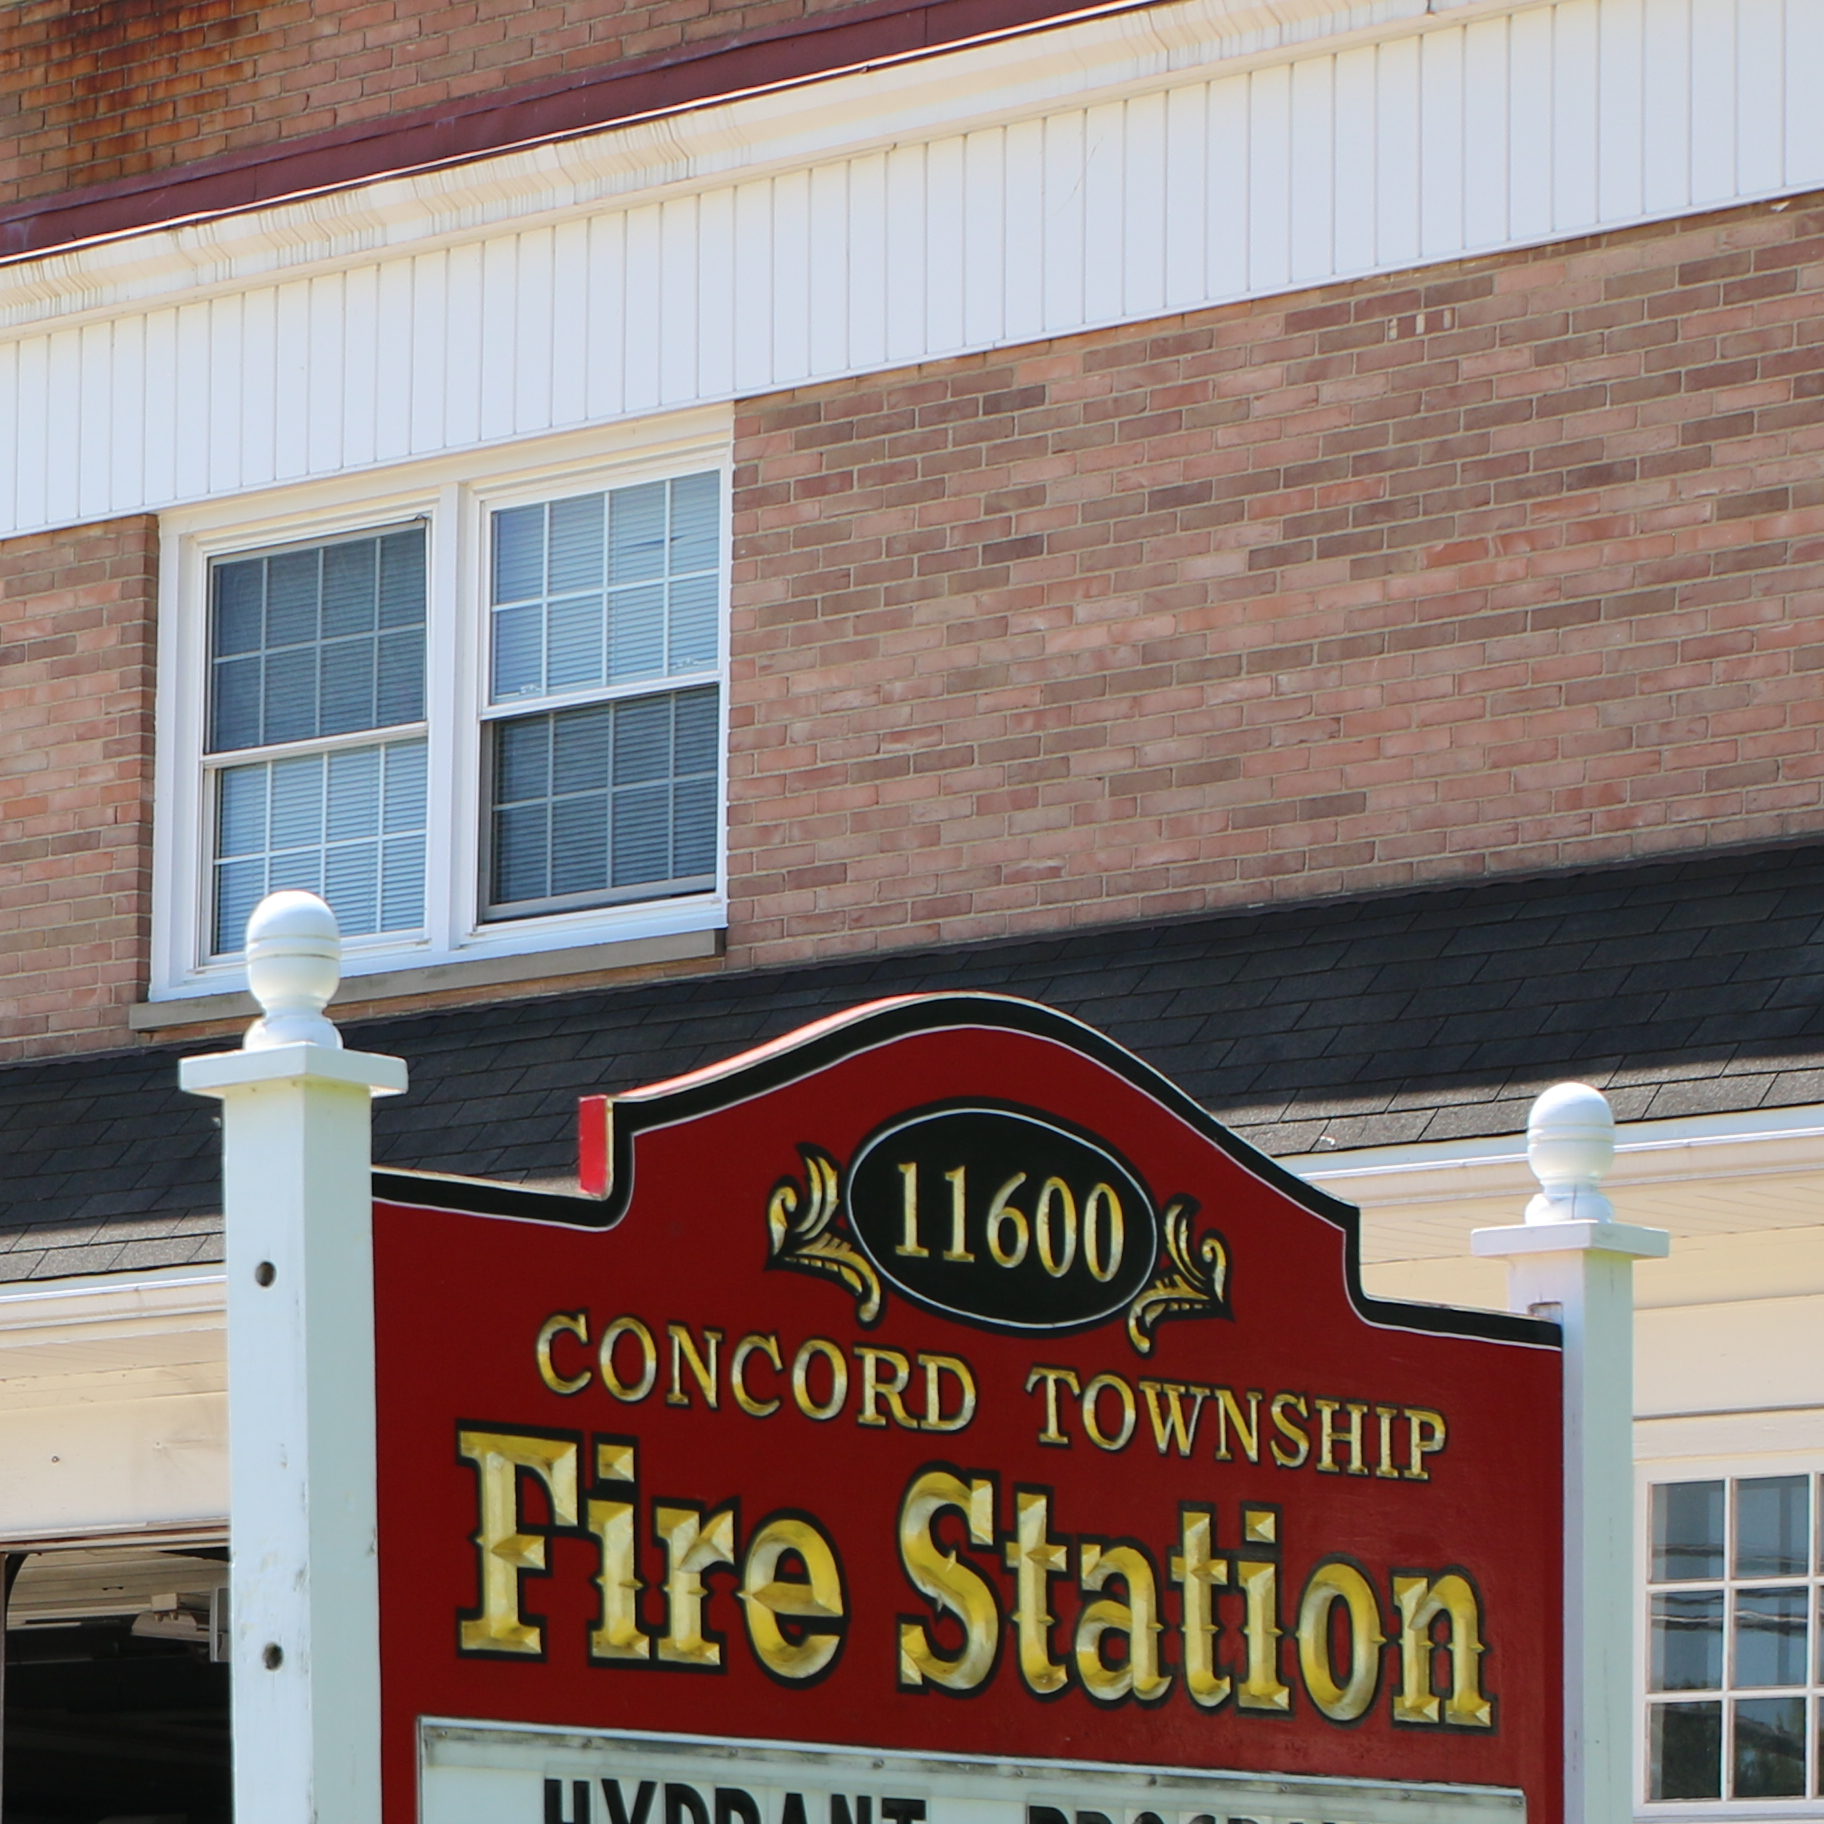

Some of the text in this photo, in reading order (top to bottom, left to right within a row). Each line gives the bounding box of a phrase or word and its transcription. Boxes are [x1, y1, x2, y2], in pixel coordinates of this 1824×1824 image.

[894, 1161, 1126, 1284] 11600
[535, 1310, 1448, 1482] CONCORD TOWNSHIP
[456, 1427, 1496, 1731] Fire Station
